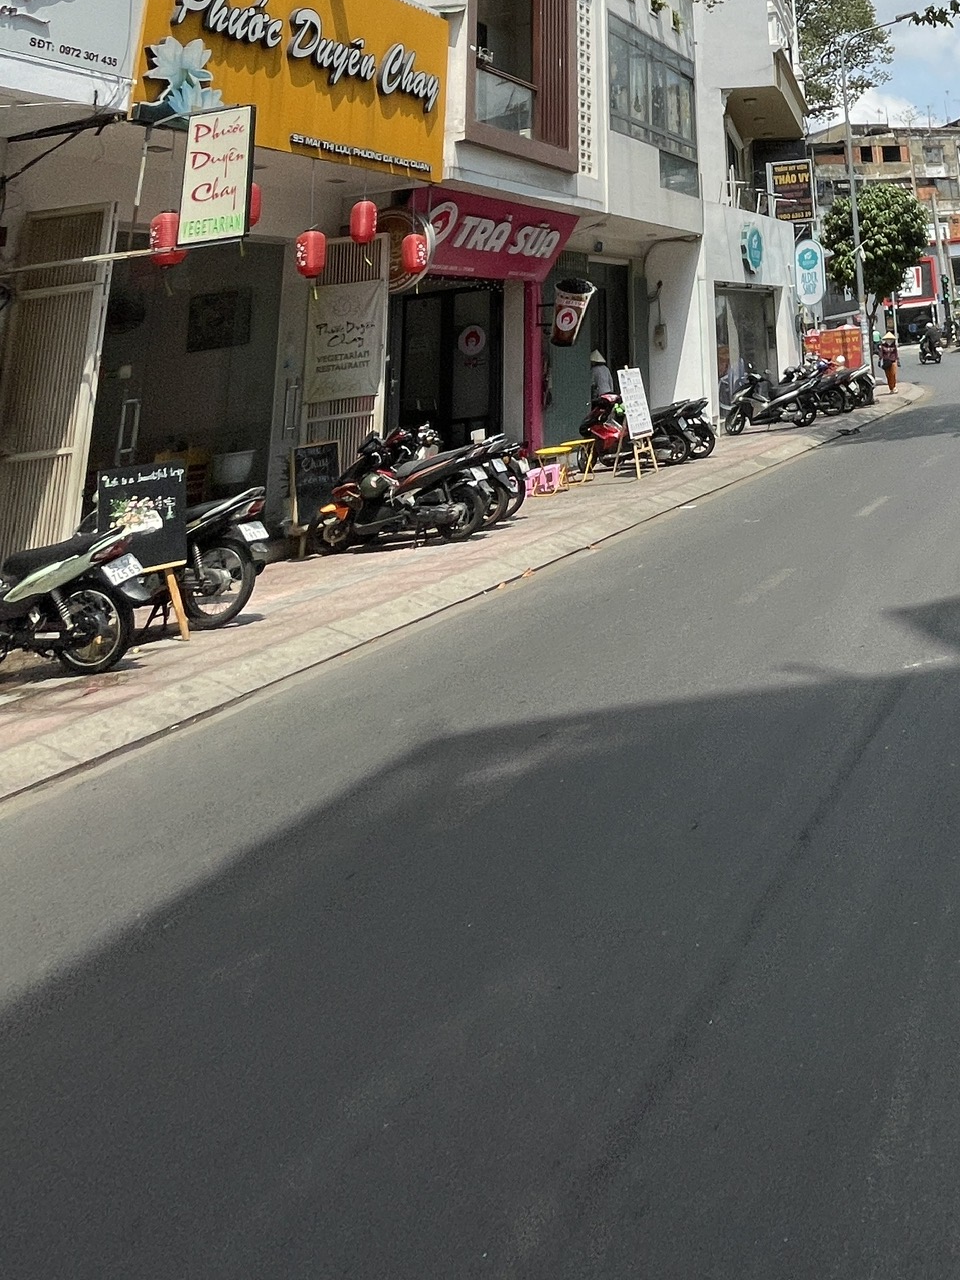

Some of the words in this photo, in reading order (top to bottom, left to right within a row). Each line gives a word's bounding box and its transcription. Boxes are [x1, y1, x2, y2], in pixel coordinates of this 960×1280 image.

[29, 37, 55, 52] SĐT:
[59, 45, 82, 58] 0972
[83, 51, 99, 62] 301
[101, 55, 118, 67] 435
[289, 8, 376, 86] Duyên
[379, 43, 440, 113] Chay
[194, 116, 245, 143] Phước
[292, 133, 304, 144] 95
[305, 136, 320, 147] MAI
[190, 148, 244, 178] Duyên
[773, 172, 797, 185] THẢO
[798, 173, 810, 183] VY
[191, 177, 237, 210] Chay
[182, 213, 242, 238] VEGETARIAN
